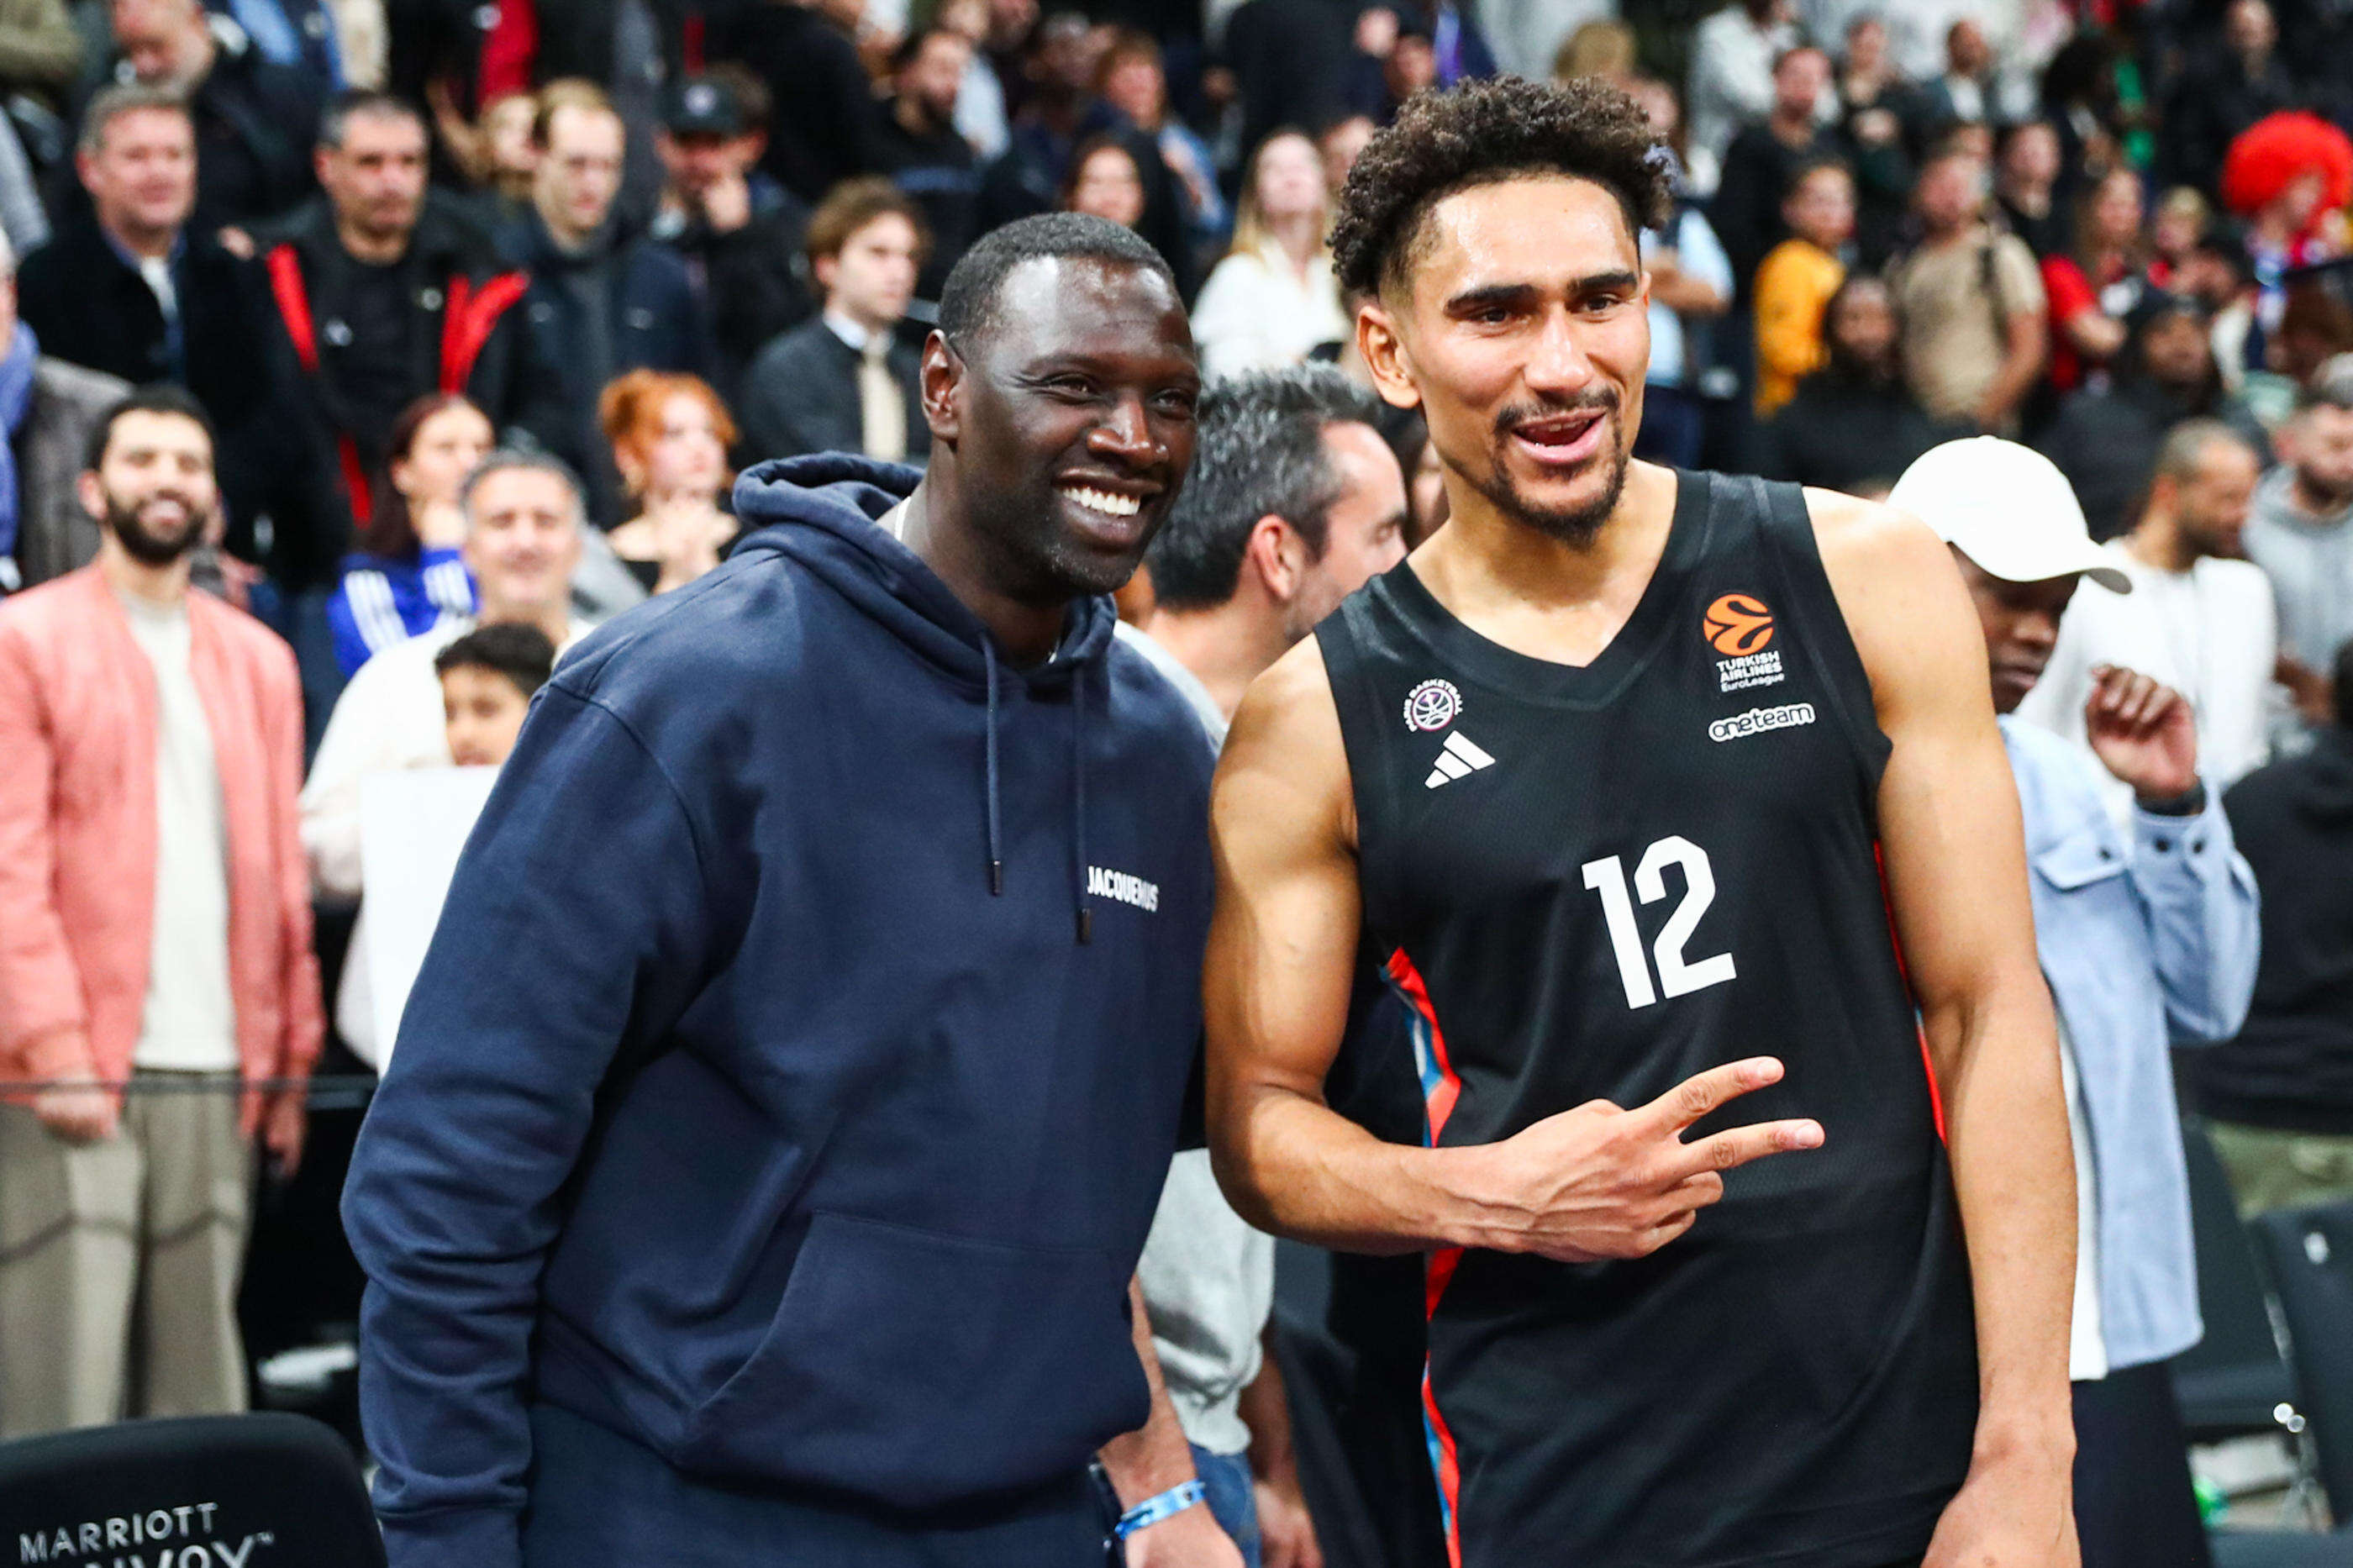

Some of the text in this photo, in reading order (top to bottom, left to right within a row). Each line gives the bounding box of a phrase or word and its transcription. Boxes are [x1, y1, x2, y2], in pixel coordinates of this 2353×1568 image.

[1716, 650, 1780, 672] TURKISH
[1720, 661, 1783, 683] AIRLINES
[1721, 673, 1785, 692] EuroLeague
[1710, 705, 1814, 740] oneteam
[1087, 866, 1159, 912] JACQUEMUS
[1581, 835, 1737, 1010] 12
[18, 1502, 218, 1565] MARRIOTT
